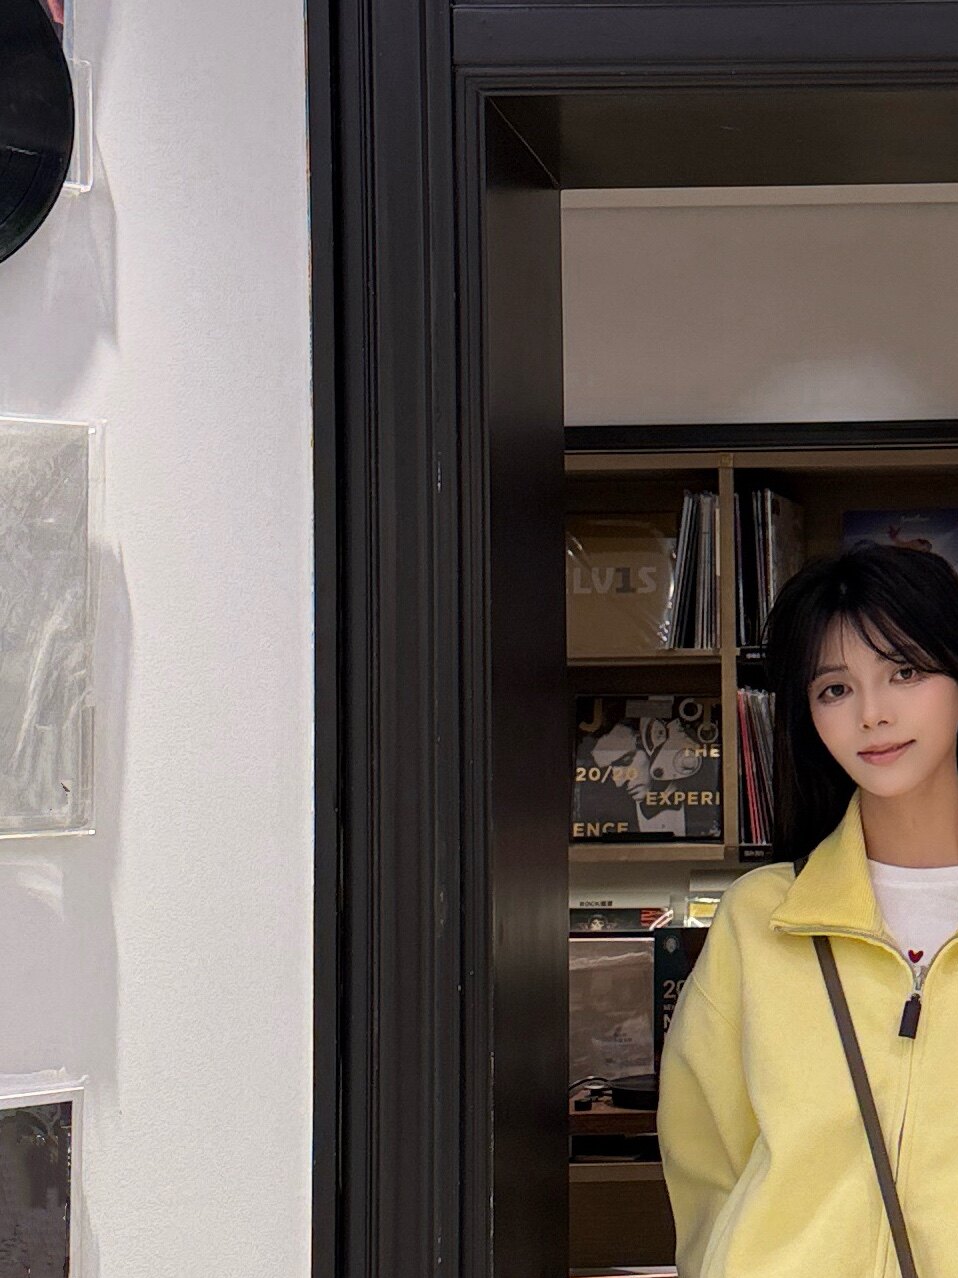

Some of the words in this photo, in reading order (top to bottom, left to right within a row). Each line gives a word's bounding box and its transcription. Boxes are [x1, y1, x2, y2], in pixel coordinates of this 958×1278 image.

[566, 567, 657, 593] LV1S
[684, 744, 721, 758] THE
[575, 766, 638, 783] 20/20
[646, 791, 720, 806] EXPERI
[572, 822, 629, 837] ENCE
